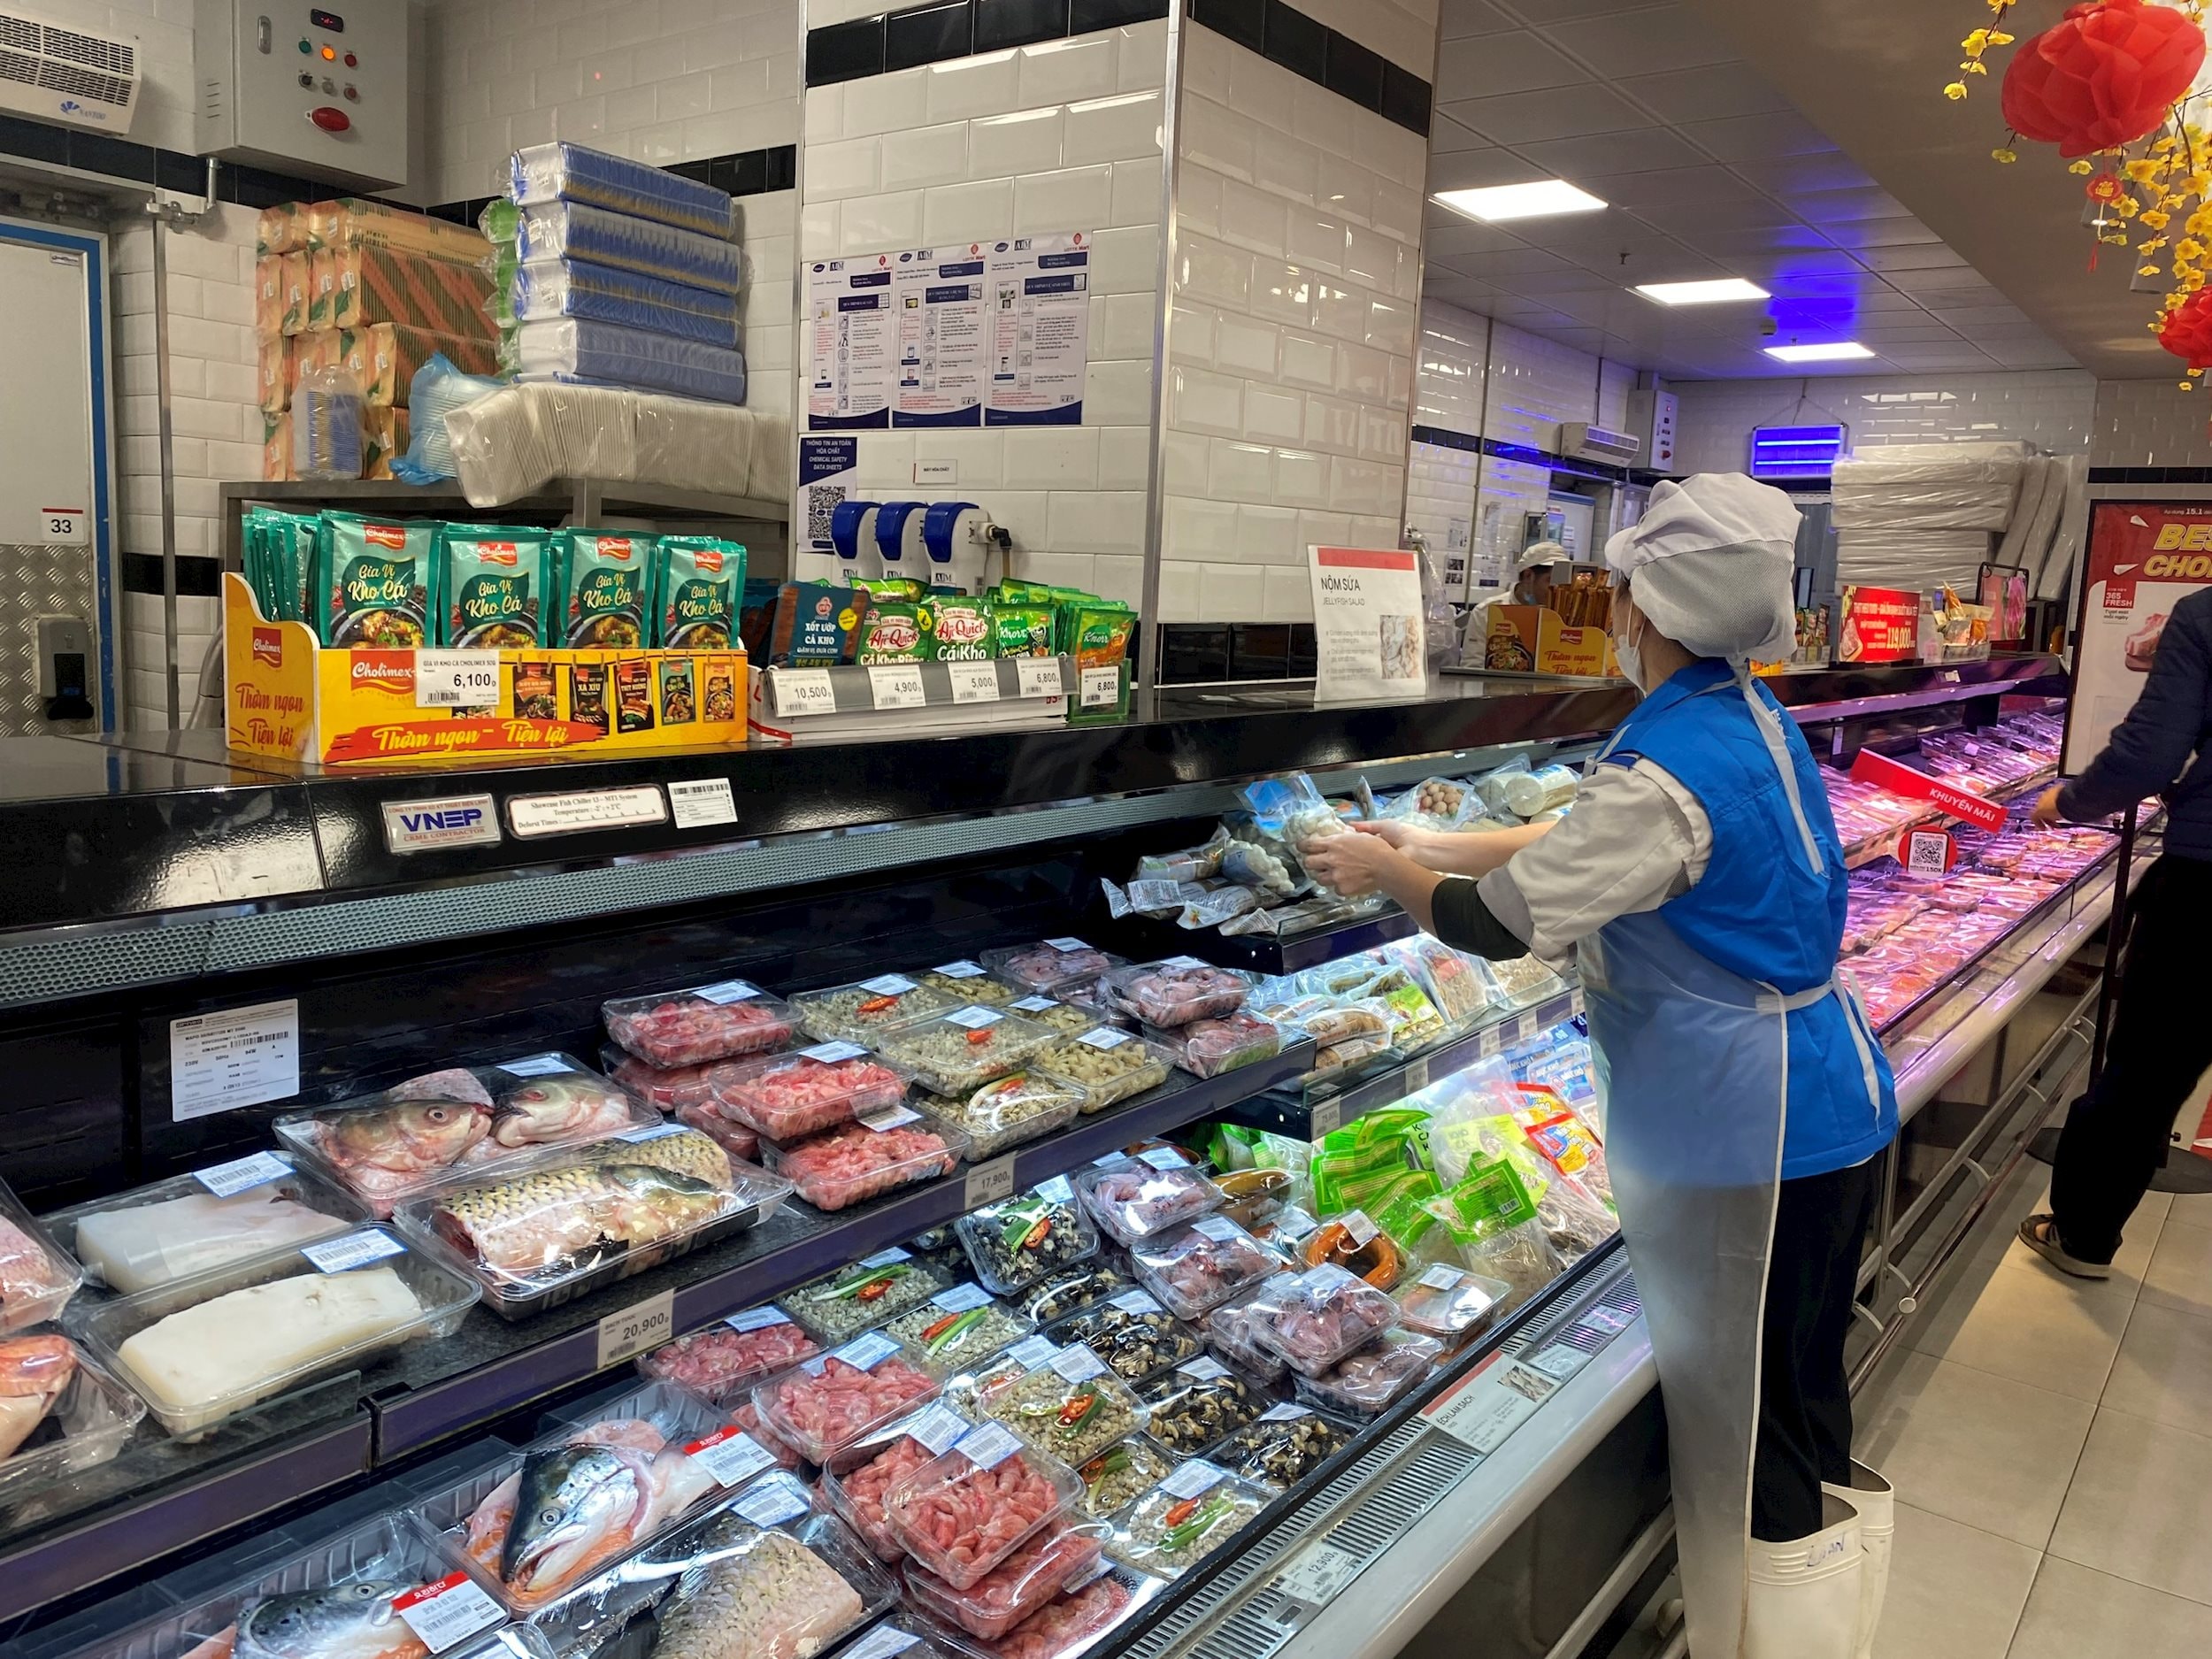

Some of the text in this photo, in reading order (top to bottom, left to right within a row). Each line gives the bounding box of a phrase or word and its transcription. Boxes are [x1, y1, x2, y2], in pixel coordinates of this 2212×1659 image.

[50, 518, 73, 534] 33
[365, 527, 404, 541] Cholimex
[358, 564, 396, 580] Gia Vị
[2143, 554, 2212, 579] CHO
[595, 572, 626, 591] Gia Vị
[935, 572, 952, 582] AIM
[1321, 574, 1361, 594] NỘM SỨA
[348, 580, 379, 602] Kho
[479, 580, 513, 596] Gia Vị
[690, 585, 708, 600] Gia
[465, 595, 522, 618] Kho Cá
[583, 587, 633, 609] Kho Cá
[1323, 596, 1365, 606] JELLYFISH SALAD
[680, 596, 724, 618] Kho Cá
[804, 634, 835, 645] CÁ KHO
[868, 628, 919, 650] Aji-Quick
[1083, 632, 1110, 643] Knorr
[253, 639, 281, 654] Cholimex
[936, 644, 956, 662] Cá
[959, 644, 987, 661] Kho
[1573, 655, 1596, 664] ngon
[351, 661, 416, 680] Cholimex
[1036, 672, 1056, 684] 6,800
[453, 673, 491, 689] 6,100
[894, 681, 918, 694] 4,900
[971, 677, 993, 690] 5,000
[1097, 680, 1116, 692] 6,800
[234, 682, 304, 719] Thơm ngon
[794, 686, 828, 701] 10,500
[247, 718, 295, 753] Tiện lợi
[372, 719, 570, 753] Thơm ngon Tiện lợi
[531, 800, 558, 809] Showcase
[572, 797, 592, 806] Chiller
[619, 794, 639, 804] System
[1929, 787, 1996, 823] KHUYẾN MÃI
[400, 809, 482, 832] VNEP
[430, 827, 486, 840] CONTRACTOR
[981, 1171, 1009, 1190] 17,900
[622, 1311, 665, 1340] 20,900
[1435, 1410, 1452, 1426] ẾCH
[1458, 1394, 1476, 1409] SẠCH
[413, 1580, 447, 1600] 요리하다
